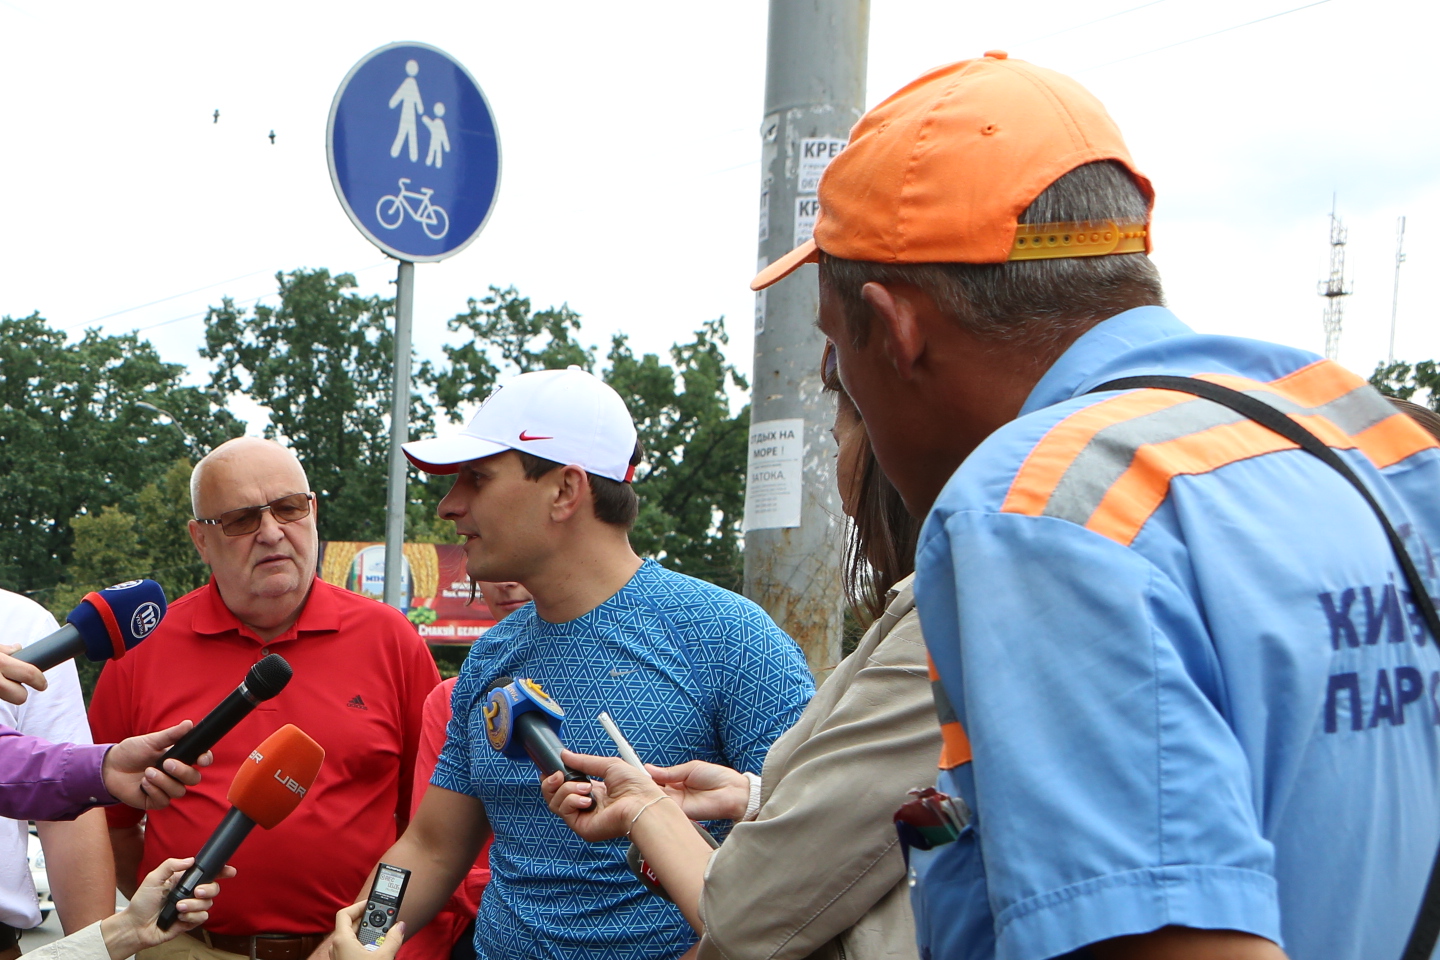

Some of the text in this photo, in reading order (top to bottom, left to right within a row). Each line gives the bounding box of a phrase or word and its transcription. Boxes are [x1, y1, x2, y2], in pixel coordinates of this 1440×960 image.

[779, 430, 795, 440] НА
[753, 446, 777, 458] МОРЕ
[141, 605, 157, 633] 112
[273, 768, 307, 799] UBR
